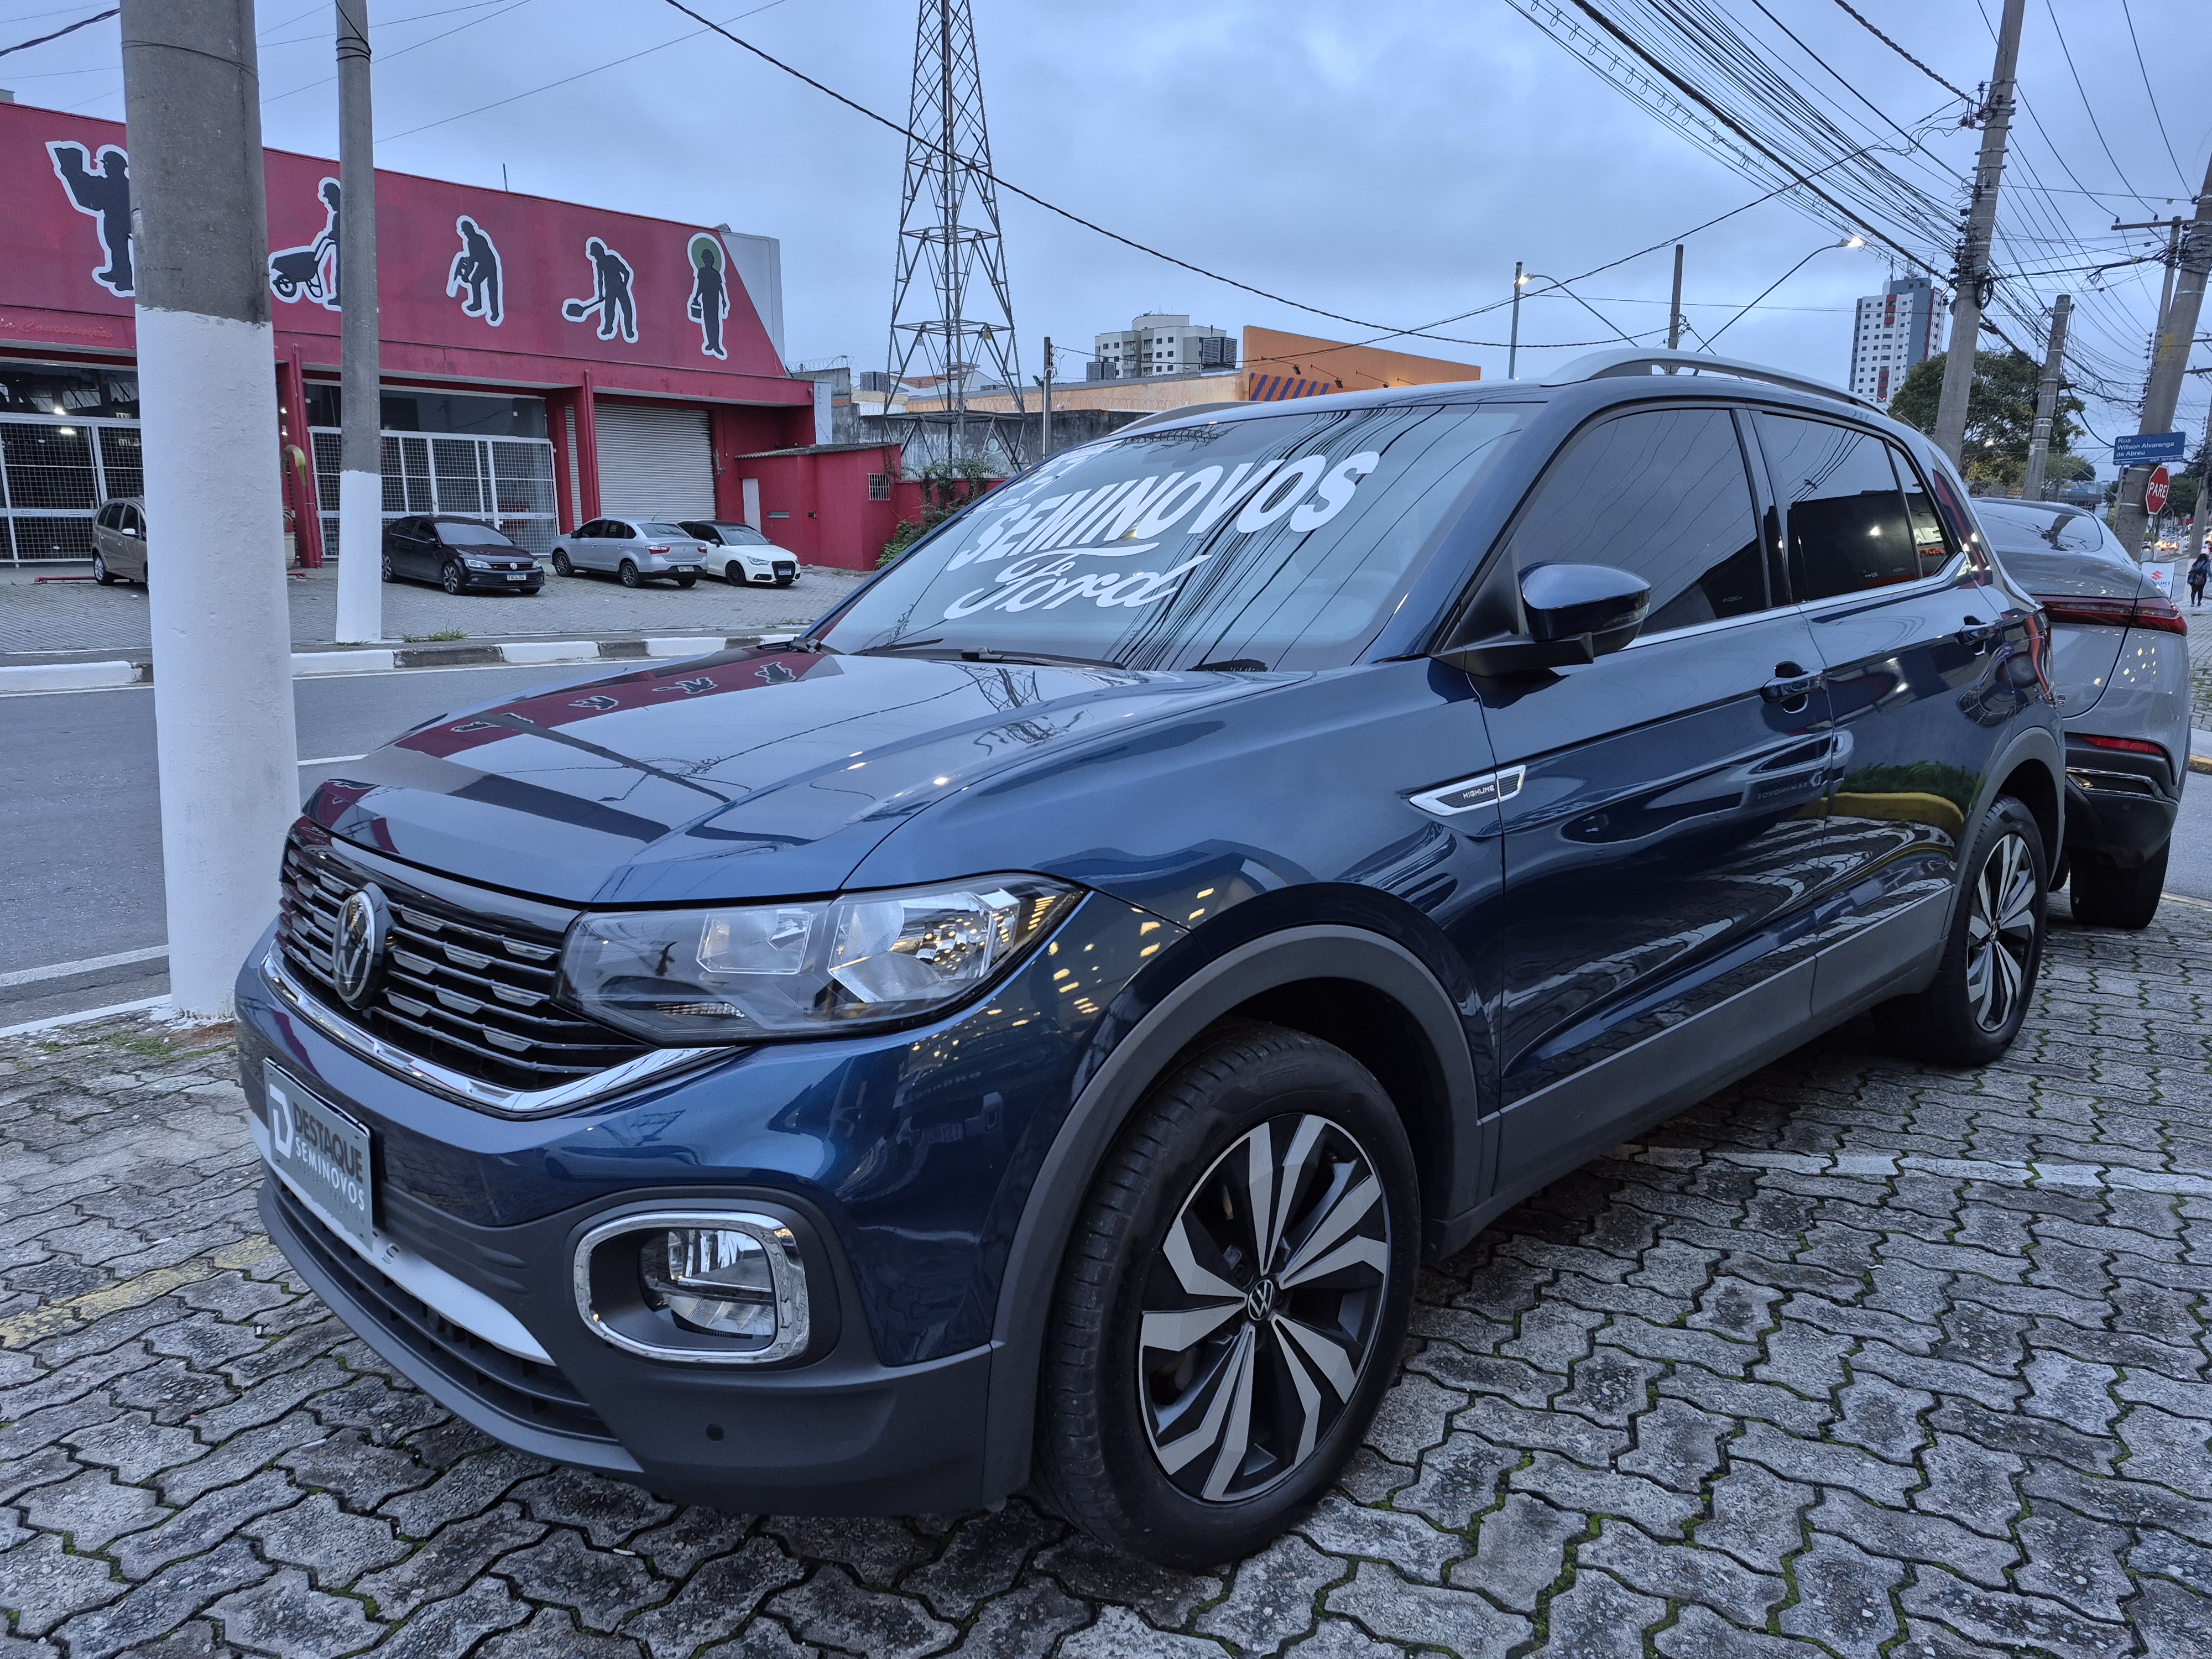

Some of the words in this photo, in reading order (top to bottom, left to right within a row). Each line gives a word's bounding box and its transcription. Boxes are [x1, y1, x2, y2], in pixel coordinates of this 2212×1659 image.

[947, 452, 1379, 571] SEMINOVOS
[2149, 482, 2167, 498] PARE
[944, 542, 1212, 619] Ford
[1463, 785, 1495, 799] HIGHLINE
[293, 1102, 363, 1185] DESTAQUE
[296, 1138, 364, 1211] SEMINOVOS
